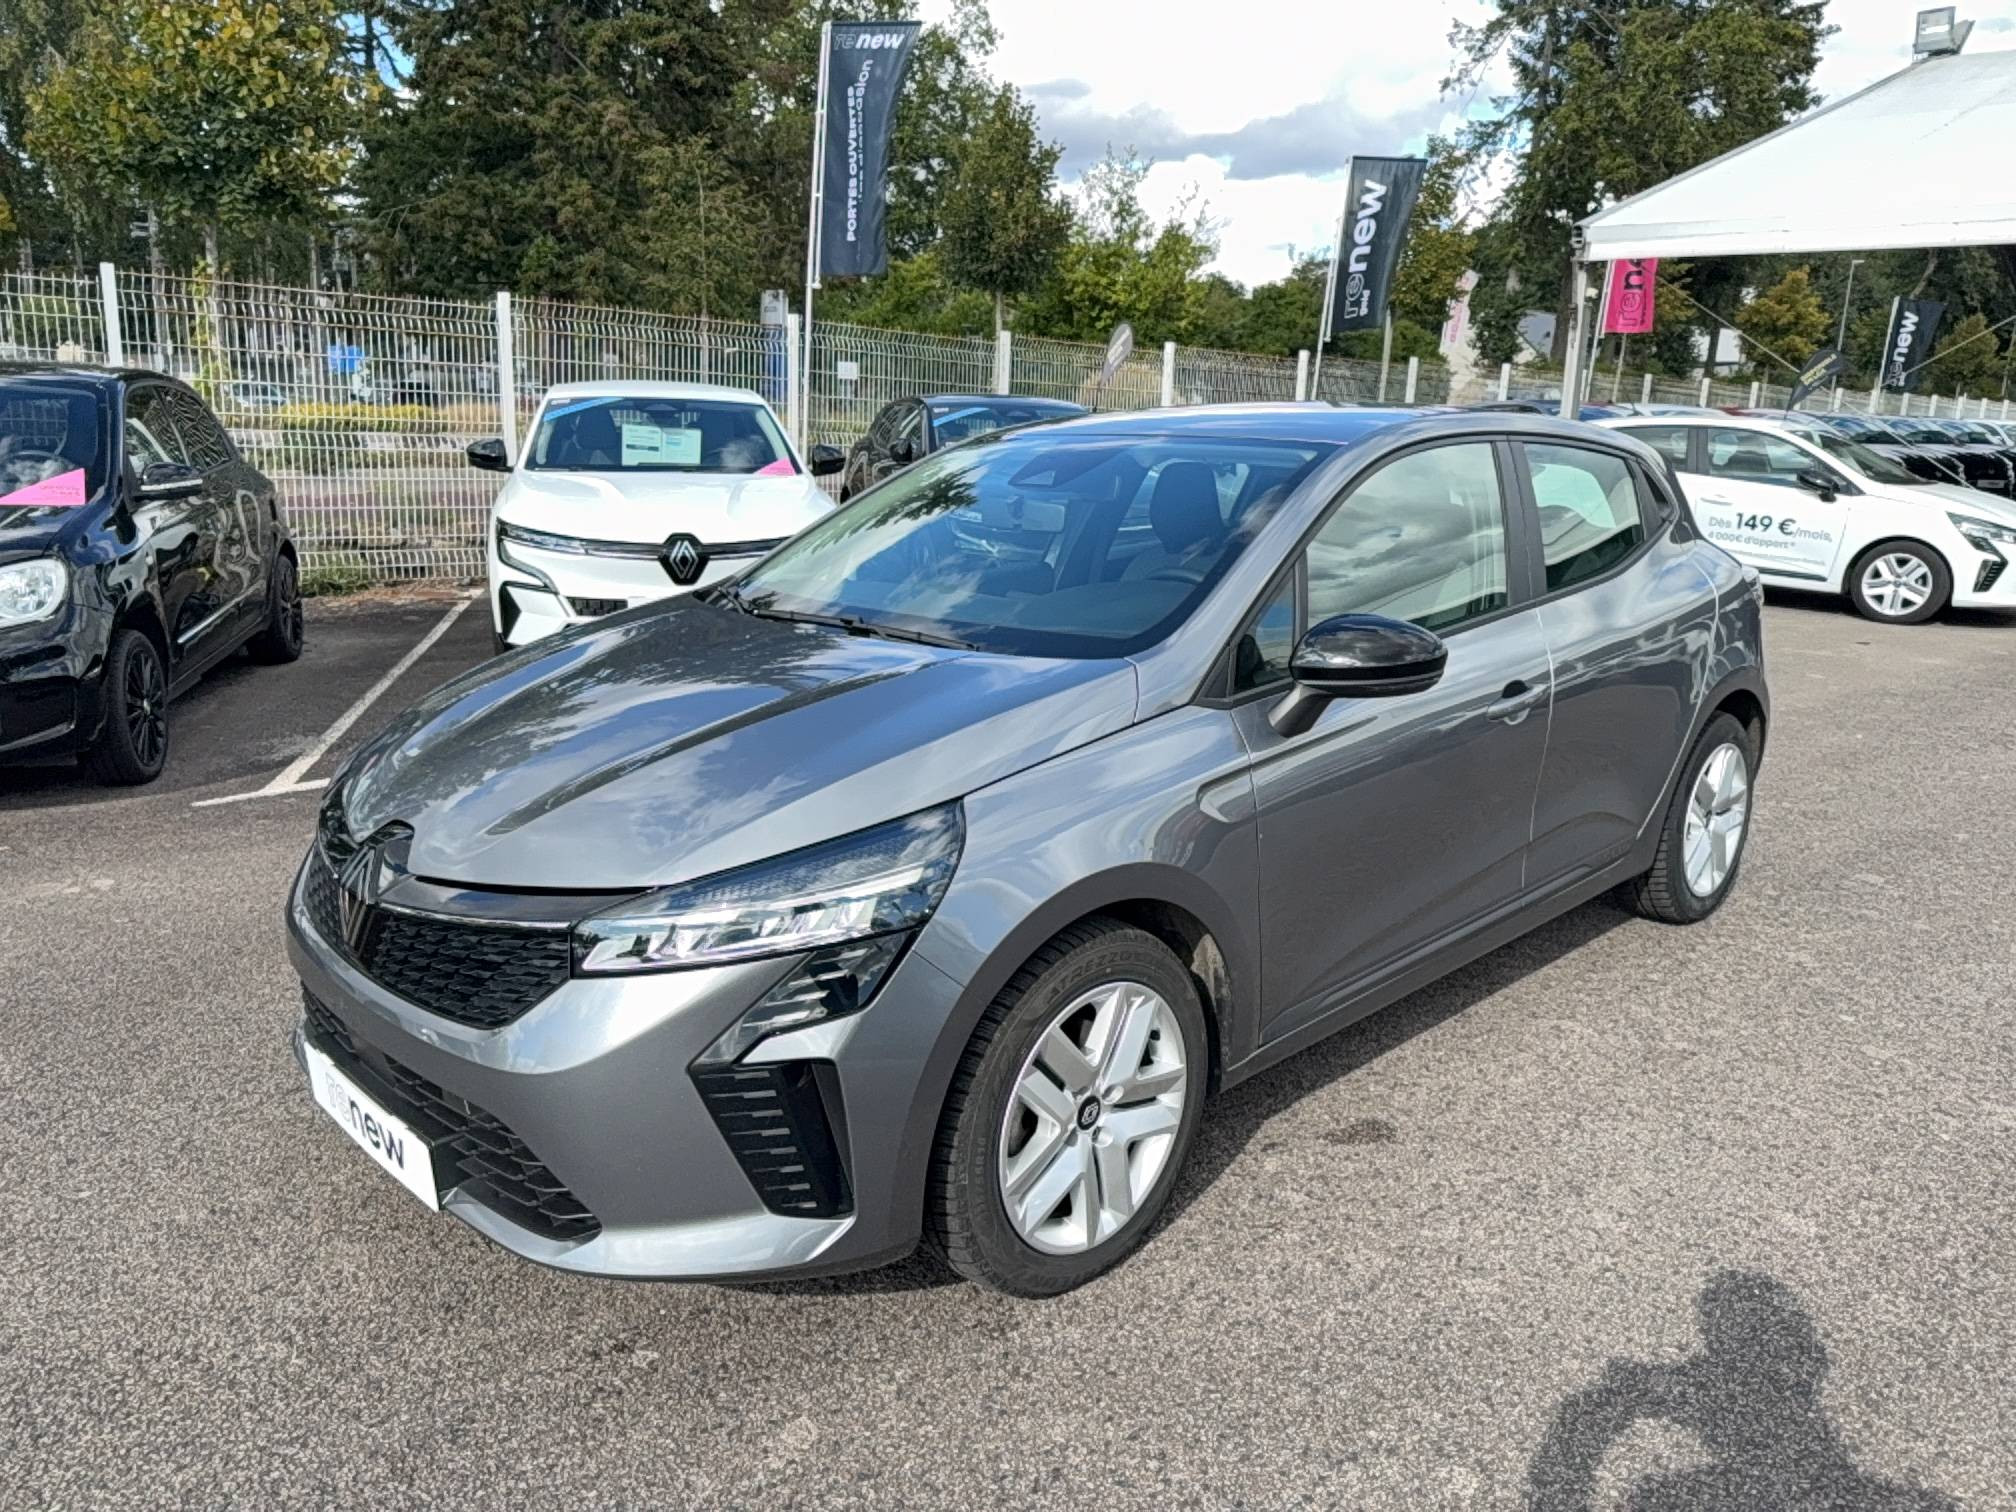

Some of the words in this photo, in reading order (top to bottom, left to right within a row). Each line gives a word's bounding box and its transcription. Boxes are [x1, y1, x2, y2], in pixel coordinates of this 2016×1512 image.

[833, 33, 906, 51] renew
[846, 86, 858, 175] OUVERTES
[846, 177, 858, 242] PORTES
[1344, 179, 1387, 319] renew
[1708, 516, 1732, 529] Dès
[1736, 512, 1773, 533] 149
[324, 1072, 405, 1169] renew
